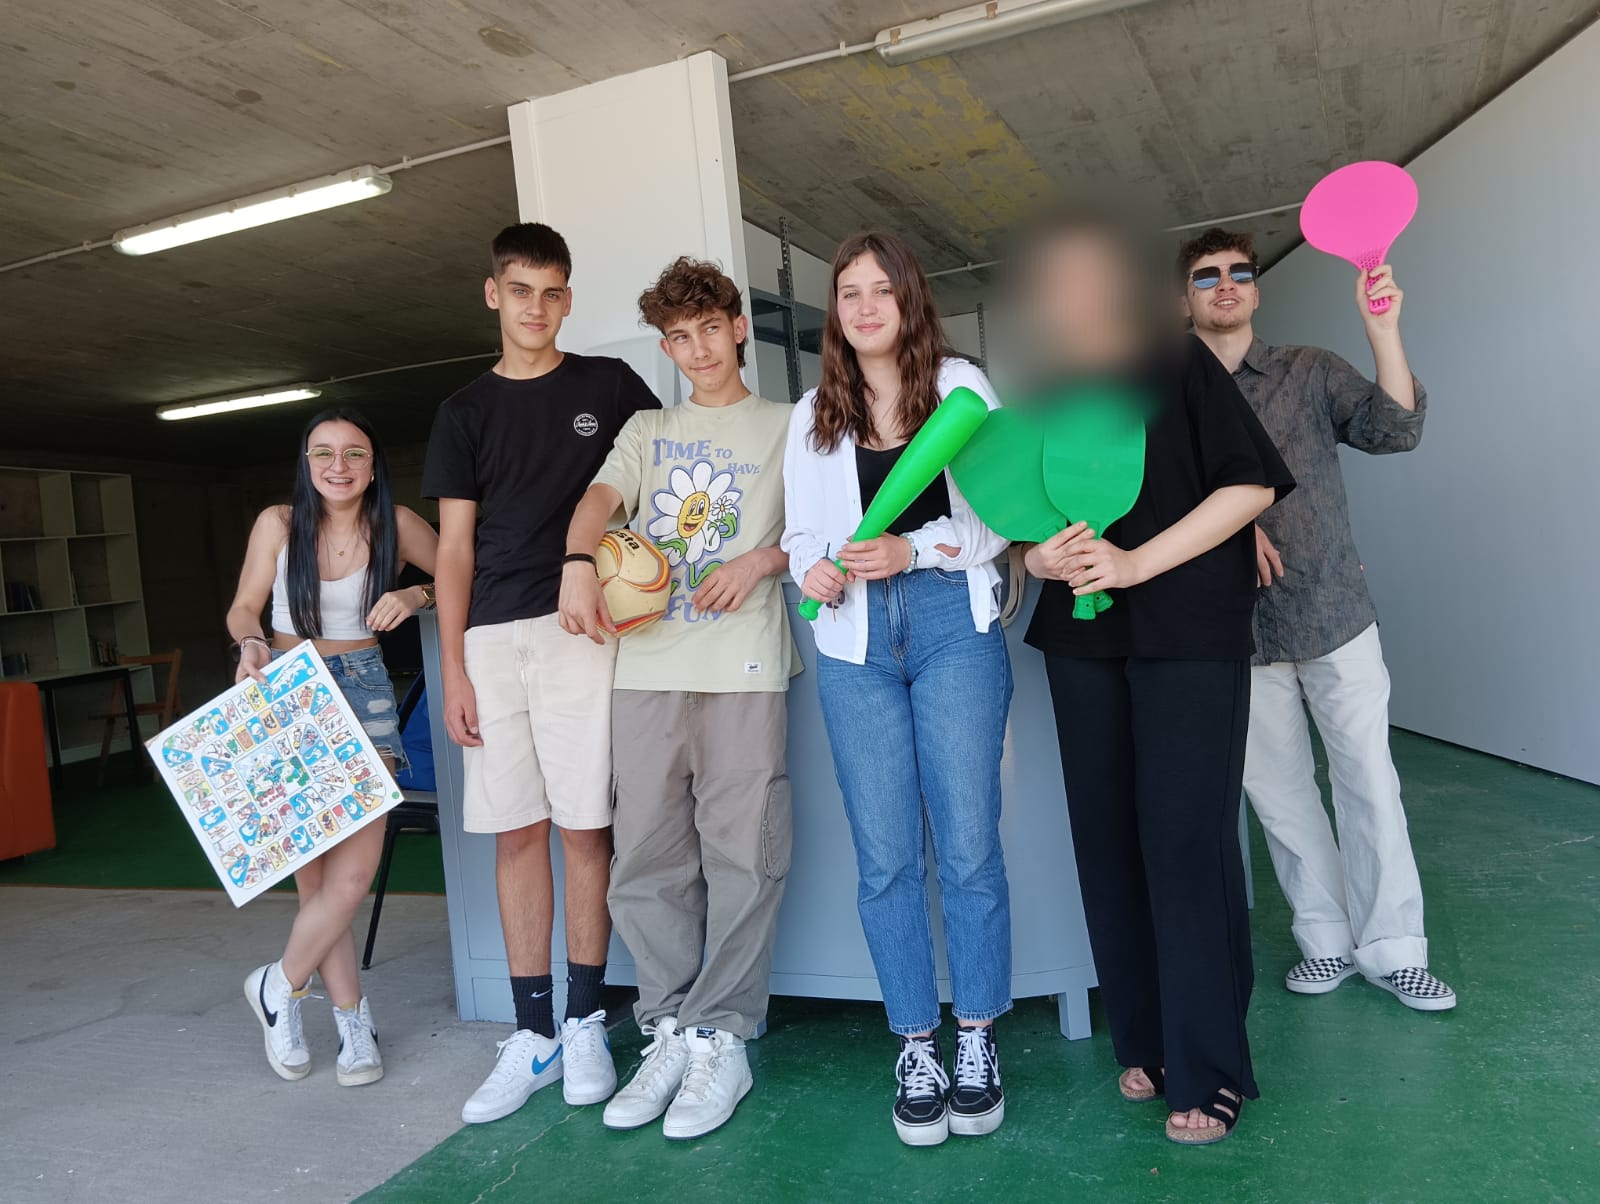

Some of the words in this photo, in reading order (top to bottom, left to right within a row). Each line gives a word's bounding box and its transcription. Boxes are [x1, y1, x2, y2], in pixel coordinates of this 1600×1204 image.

[652, 438, 712, 466] TIME
[714, 448, 733, 459] TO
[727, 462, 760, 474] HAVE
